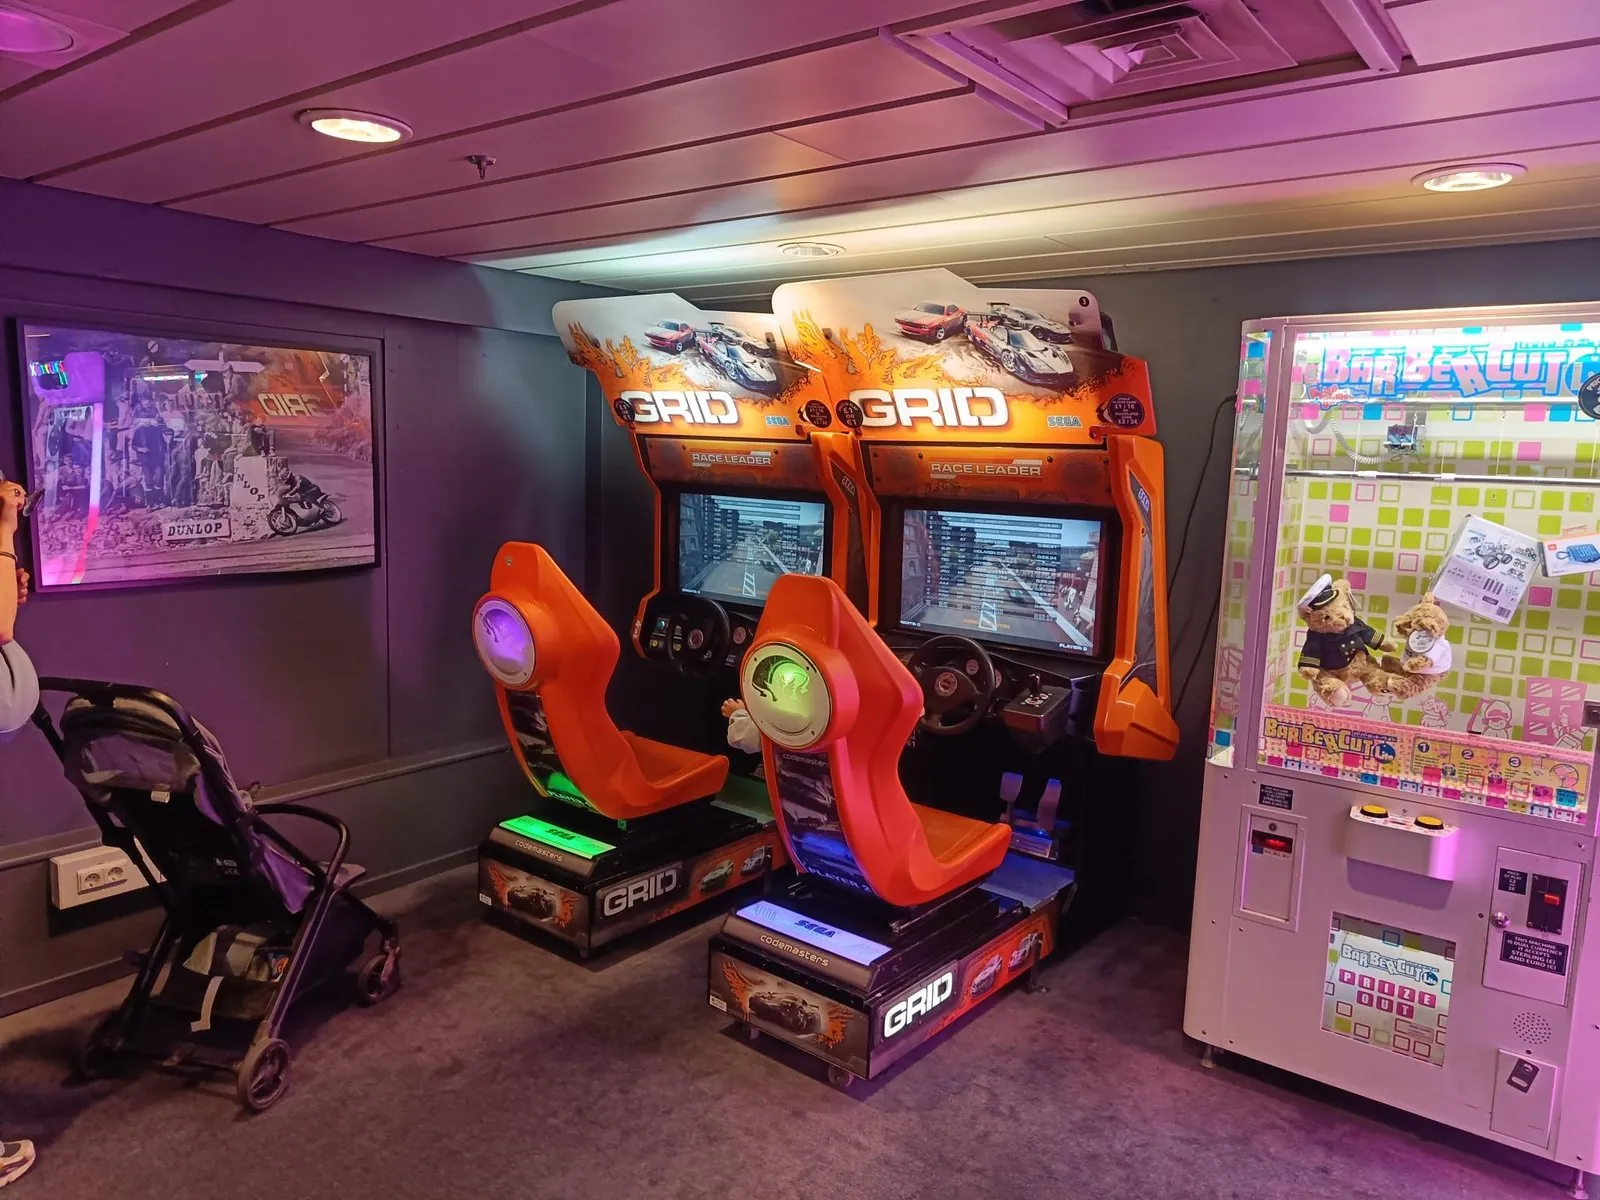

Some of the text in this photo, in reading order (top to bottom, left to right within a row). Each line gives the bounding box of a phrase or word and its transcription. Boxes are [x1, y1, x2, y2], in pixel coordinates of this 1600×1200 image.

[620, 390, 740, 424] GRID
[849, 387, 1009, 427] GRID
[764, 415, 791, 426] SEGA
[1047, 415, 1083, 428] SEGA
[692, 453, 771, 465] RACE LEADER
[931, 463, 1041, 476] RACE LEADER
[167, 522, 222, 536] DUNLOP
[782, 752, 830, 767] codemaster
[515, 840, 563, 861] codemasters
[604, 869, 677, 916] GRID
[794, 919, 836, 938] SEGA
[760, 934, 829, 967] codemasters
[1513, 941, 1529, 949] DUAL
[1530, 944, 1563, 956] CURRENCY
[1528, 939, 1557, 949] MACHINE
[1511, 950, 1545, 962] STERLING
[1524, 948, 1550, 958] ACCEPTS
[1509, 955, 1525, 963] AND
[1525, 957, 1546, 967] EURO
[1343, 972, 1431, 1005] PRIZE
[884, 971, 953, 1038] GRID
[1361, 993, 1410, 1016] OUT
